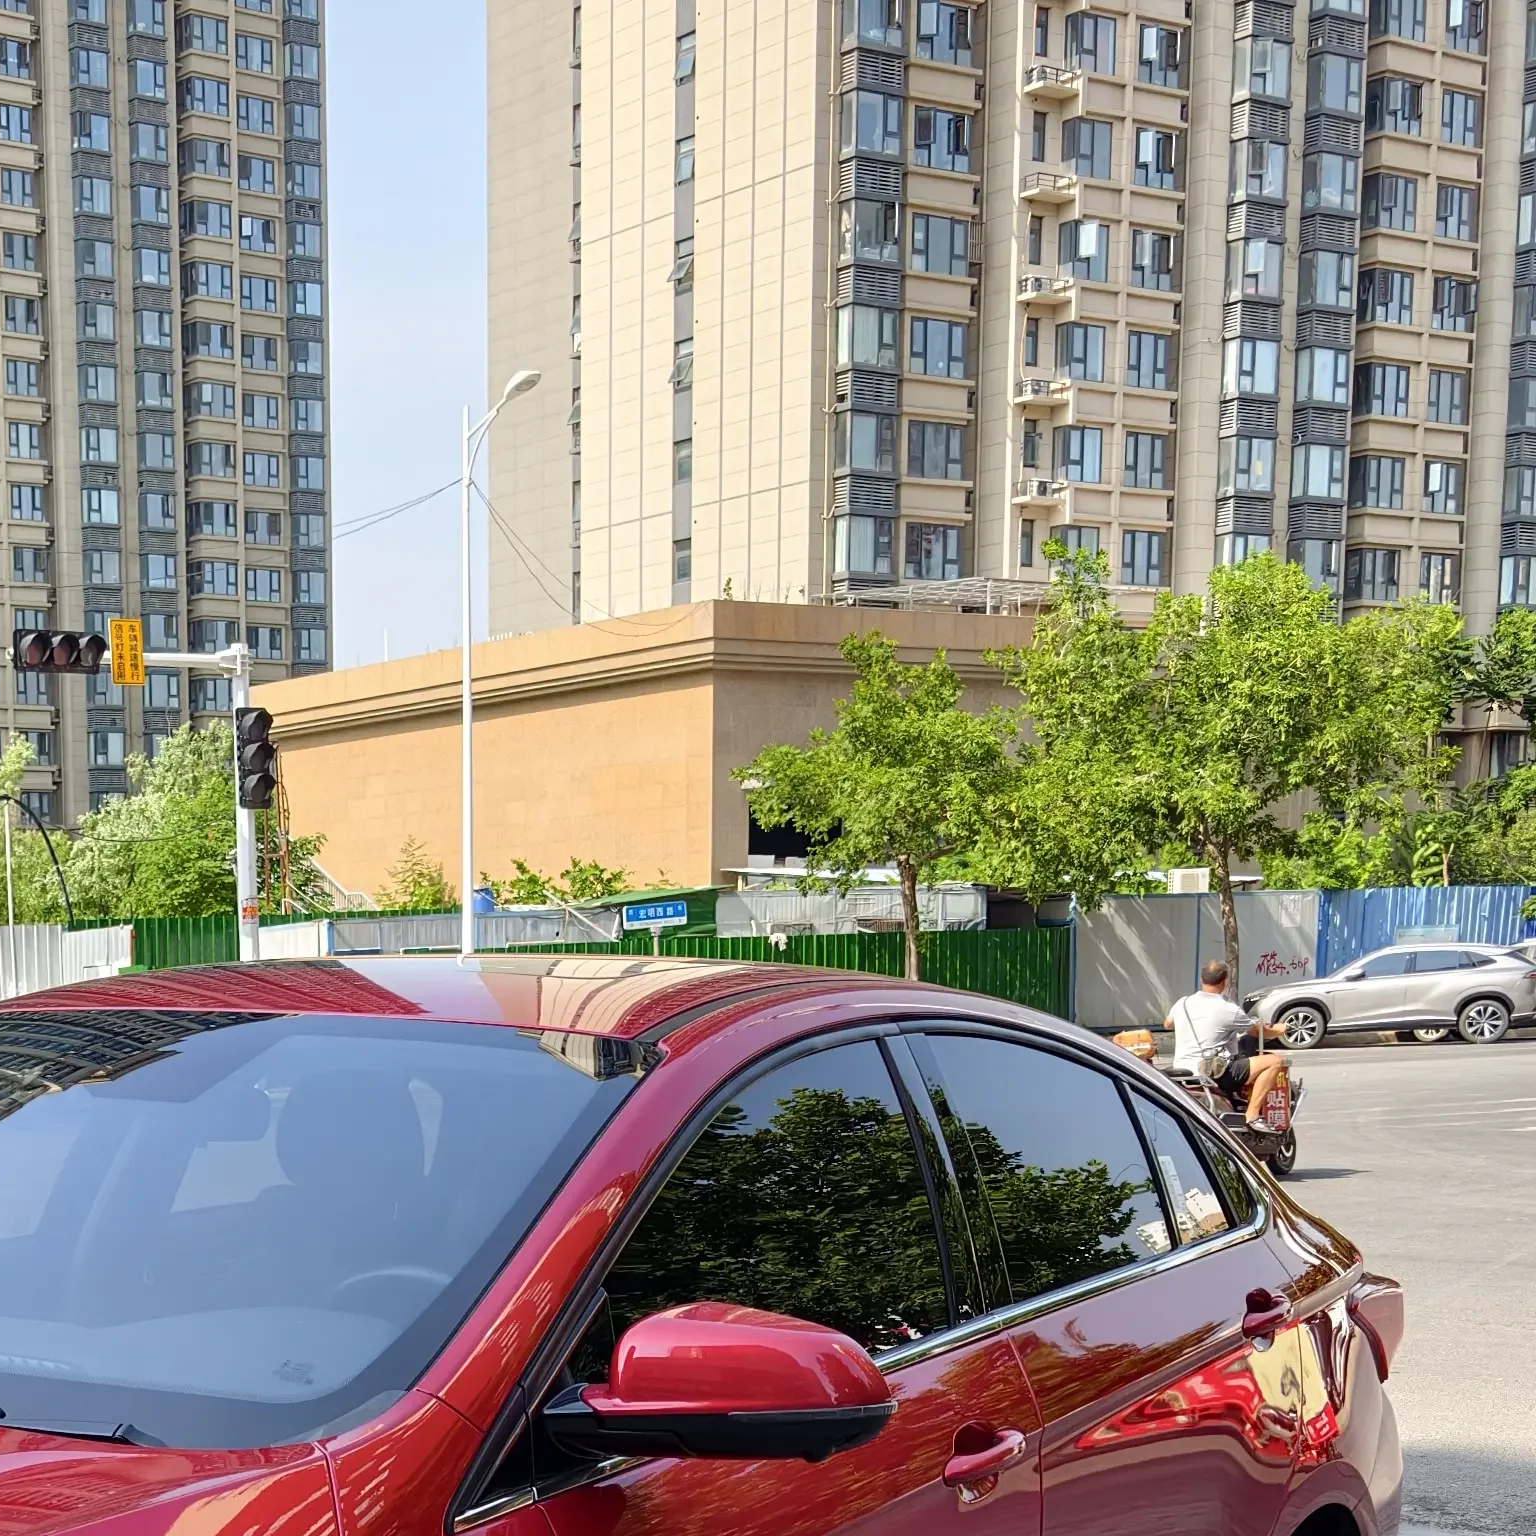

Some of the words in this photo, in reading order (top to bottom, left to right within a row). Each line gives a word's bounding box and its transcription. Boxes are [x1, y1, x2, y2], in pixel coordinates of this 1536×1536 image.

[115, 623, 125, 680] 信号灯未启用
[128, 624, 139, 680] 车辆减速慢行
